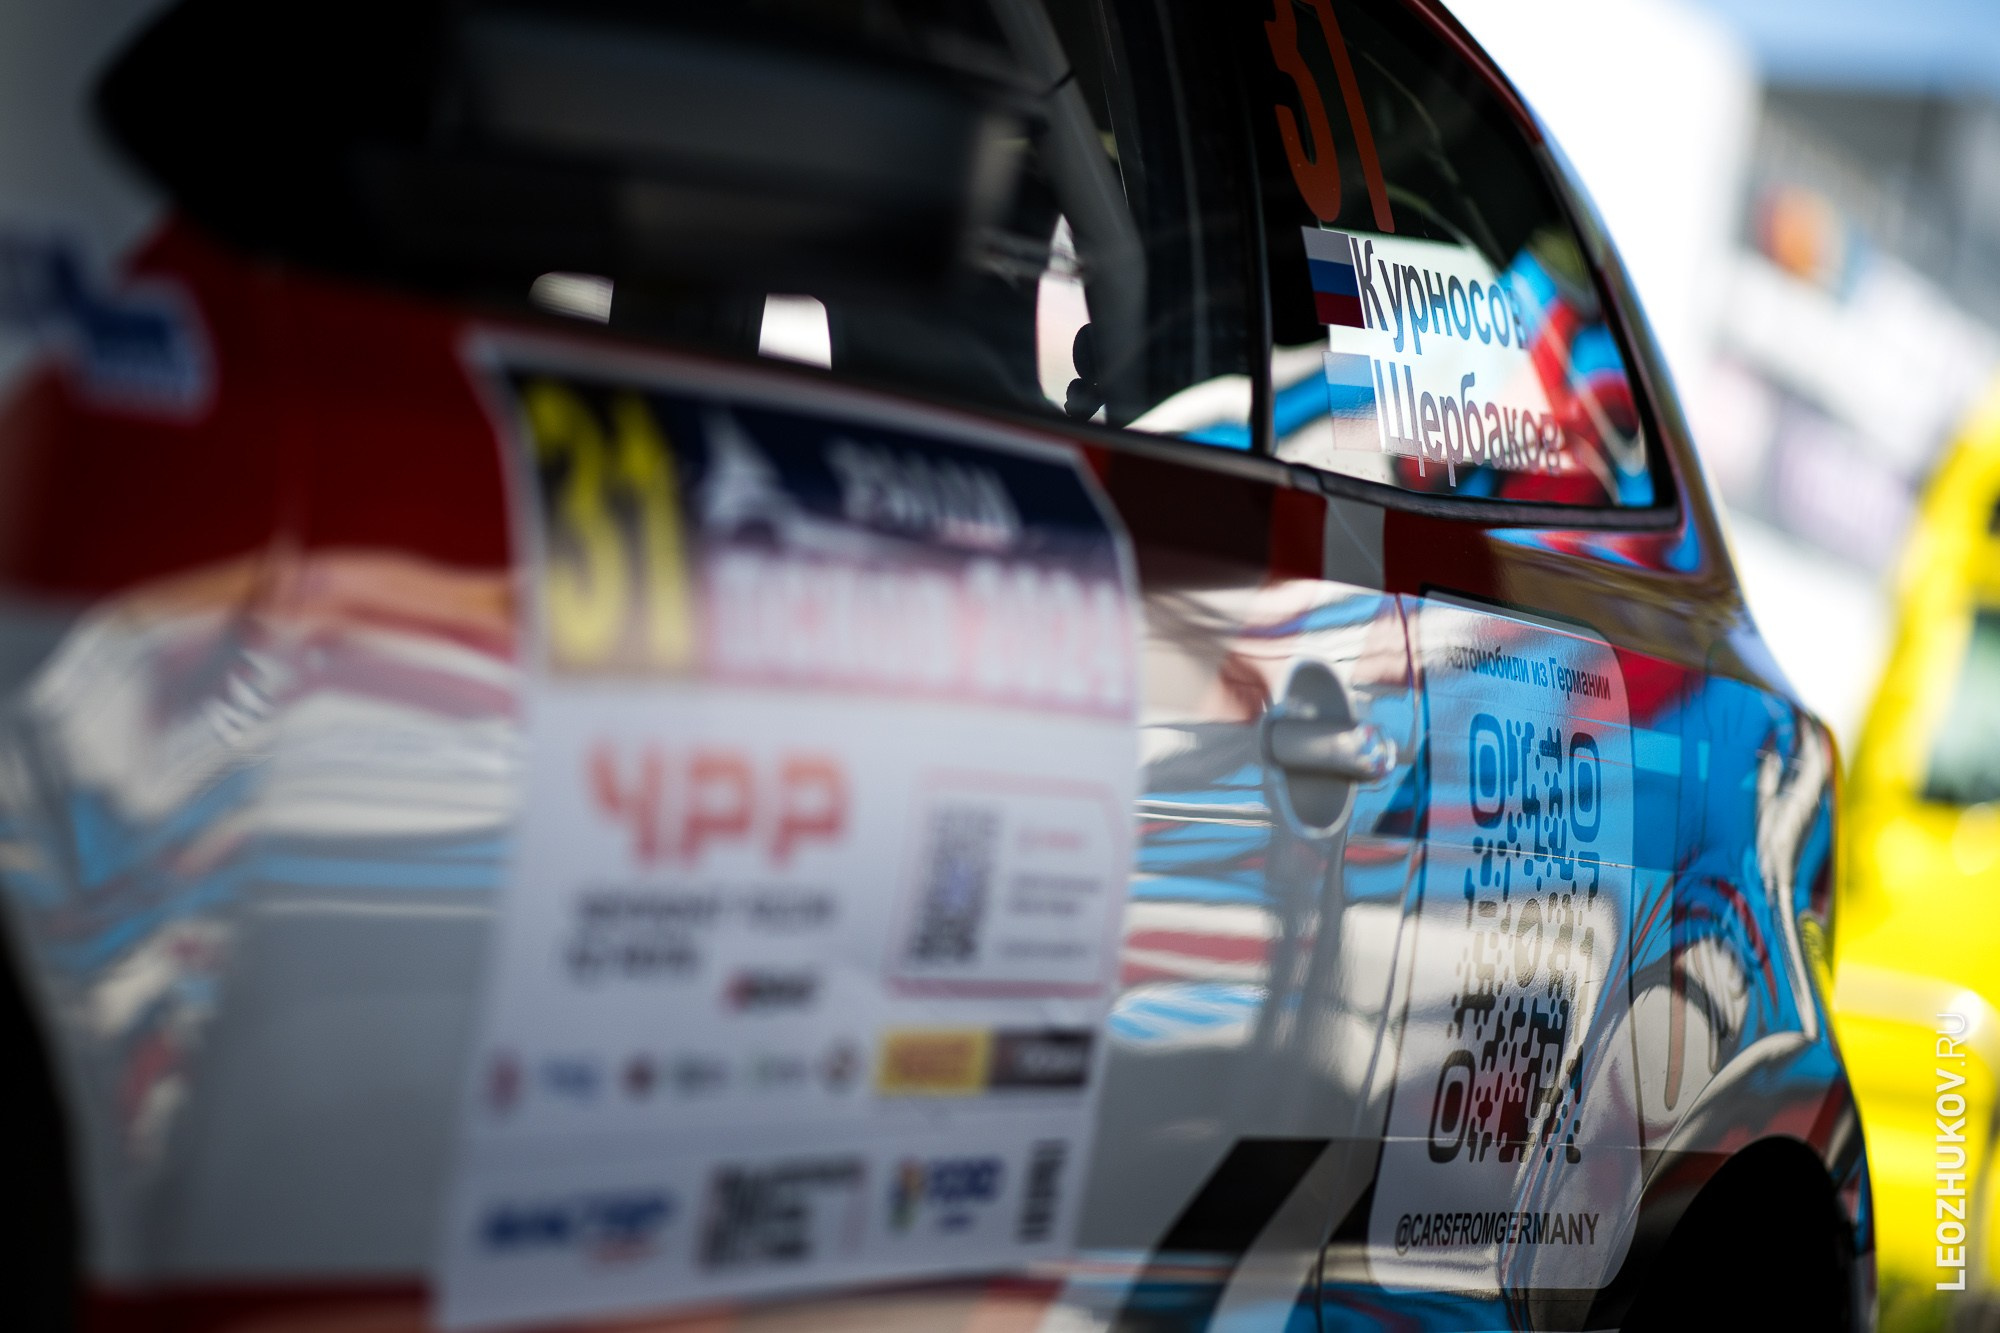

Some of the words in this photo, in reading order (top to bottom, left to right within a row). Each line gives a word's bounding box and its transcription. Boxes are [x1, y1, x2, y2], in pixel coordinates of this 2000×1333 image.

[1264, 0, 1395, 233] 31
[1374, 358, 1565, 487] Щербаков
[523, 384, 692, 668] 31
[1530, 660, 1548, 688] из
[1548, 656, 1611, 700] Германии
[1395, 1212, 1599, 1256] @CARSFROMGERMANY
